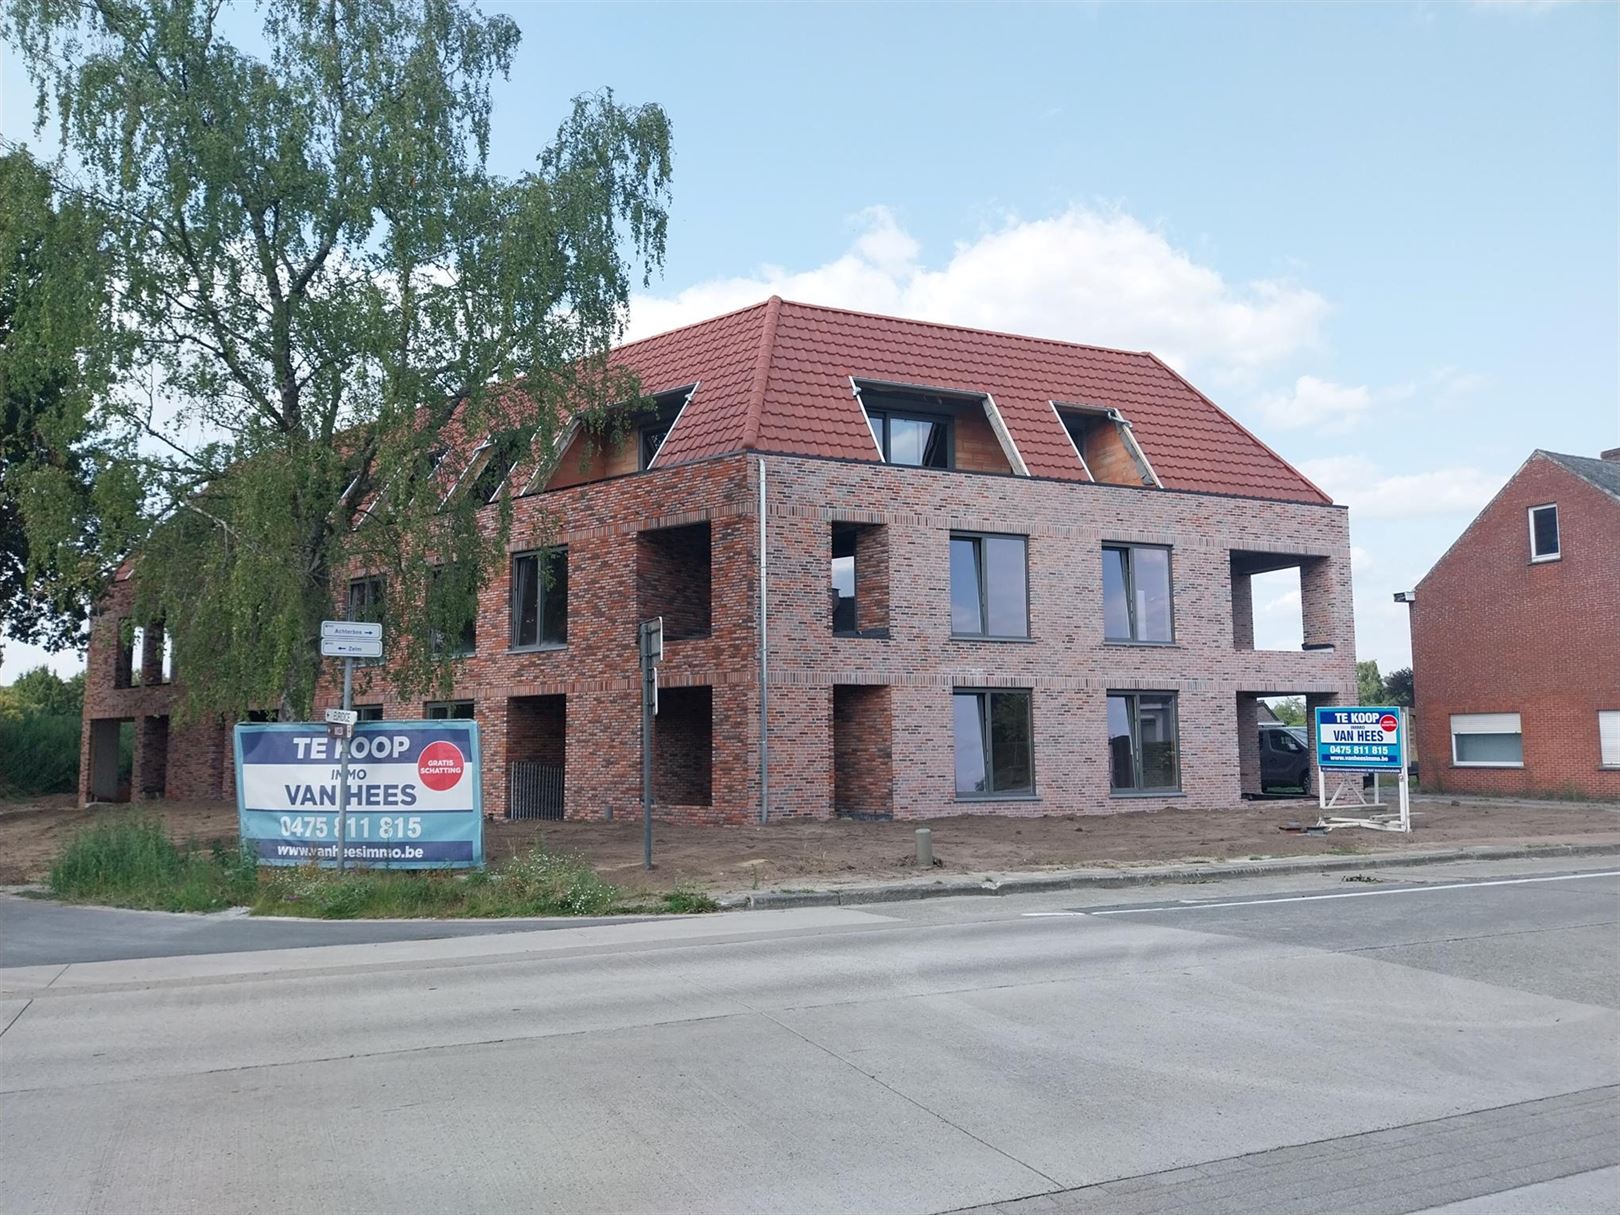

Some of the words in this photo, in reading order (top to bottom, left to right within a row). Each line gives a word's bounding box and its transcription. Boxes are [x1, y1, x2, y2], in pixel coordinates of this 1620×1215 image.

[1335, 712, 1348, 723] TE
[1351, 712, 1380, 723] KOOP
[1333, 730, 1354, 742] VAN
[1358, 730, 1384, 742] HEES
[293, 737, 328, 759] TE
[1330, 745, 1351, 754] 0475
[1353, 746, 1369, 754] 811
[1372, 746, 1388, 755] 815
[427, 759, 455, 767] GRATIS
[420, 766, 462, 775] SCHATTING
[285, 784, 336, 806] VAN
[346, 784, 417, 806] HEES
[280, 815, 328, 837] 0475
[379, 816, 422, 839] 815
